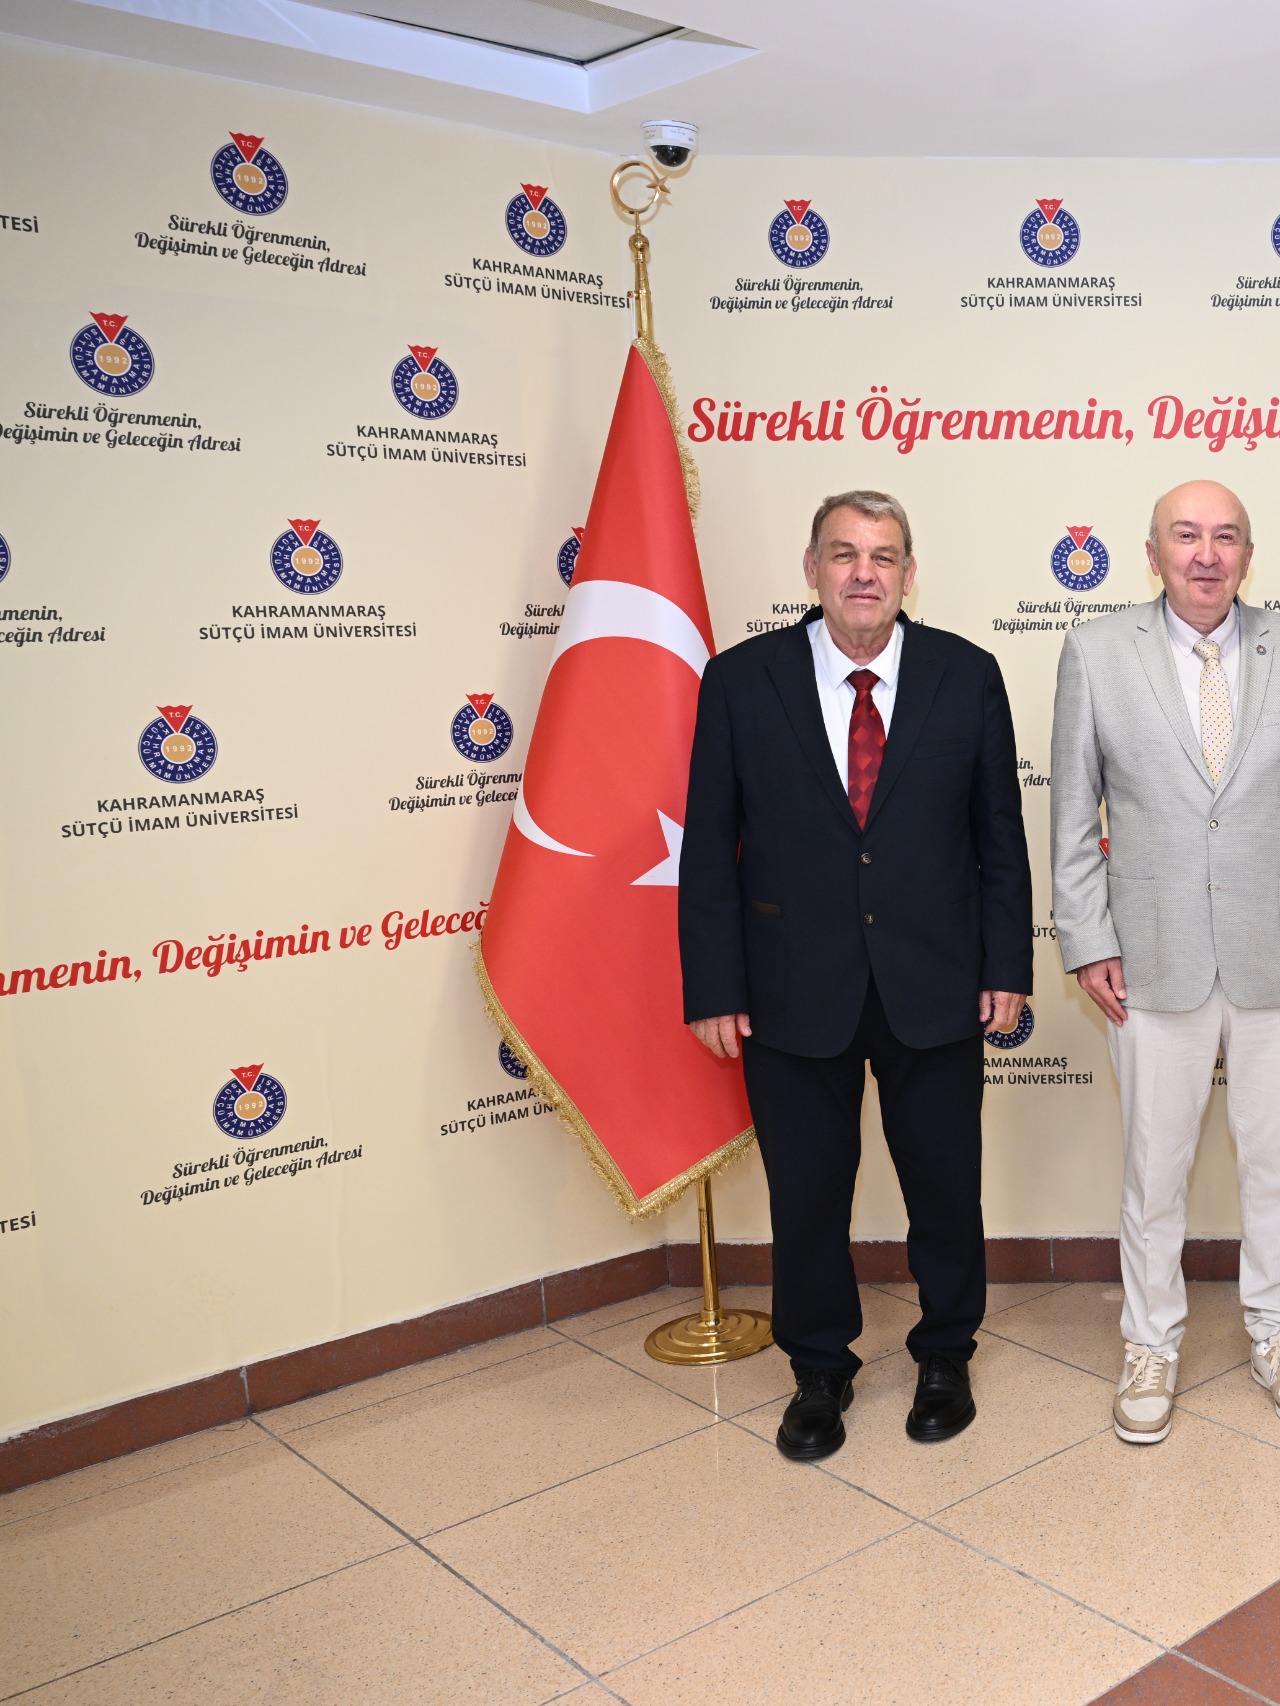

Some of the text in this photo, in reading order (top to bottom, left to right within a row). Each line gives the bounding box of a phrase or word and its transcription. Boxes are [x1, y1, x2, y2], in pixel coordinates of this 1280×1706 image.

[168, 215, 330, 253] Sürekli Öğrenmenin,
[135, 232, 366, 276] Değişimin ve Geleceğin Adresi
[473, 258, 603, 289] KAHRAMANMARAŞ
[988, 277, 1115, 291] KAHRAMANMARAŞ
[1236, 276, 1280, 289] Sürekli
[445, 273, 491, 293] SÜTÇÜ
[497, 278, 536, 297] İMAM
[735, 275, 864, 296] Sürekli Öğrenmenin,
[710, 296, 893, 313] Değişimin ve Geleceğin Adresi
[961, 293, 1141, 310] SÜTÇÜ İMAM ÜNİVERSİTESİ
[1211, 294, 1272, 311] Değişimin
[24, 402, 201, 430] Sürekli Öğrenmenin,
[688, 398, 845, 442] Sürekli
[856, 386, 1133, 454] Öğrenmenin,
[83, 433, 100, 444] ve
[105, 429, 183, 452] Geleceğin
[188, 435, 241, 452] Adresi
[357, 425, 498, 449] KAHRAMANMARAŞ
[327, 442, 526, 467] SÜTÇÜ İMAM ÜNİVERSİTESİ
[232, 605, 385, 620] KAHRAMANMARAŞ
[1017, 601, 1060, 614] Sürekli
[48, 627, 105, 644] Adresi
[199, 622, 416, 643] SÜTÇÜ İMAM ÜNİVERSİTESİ
[992, 618, 1052, 634] Değişimin
[1056, 622, 1068, 630] ve
[165, 744, 193, 753] 1992
[416, 774, 464, 790] Sürekli
[98, 788, 264, 812] KAHRAMANMARAŞ
[389, 794, 472, 813] Değişimin ve
[62, 804, 298, 838] SÜTÇÜ İMAM ÜNİVERSİTESİ
[0, 950, 142, 996] menin,
[152, 924, 331, 977] Değişimin
[340, 924, 372, 948] ve
[983, 1056, 1068, 1070] AMANMARAŞ
[1008, 1072, 1092, 1084] ÜNİVERSİTESİ
[441, 1114, 486, 1136] SÜTÇÜ
[491, 1107, 528, 1125] İMAM
[172, 1136, 328, 1179] Sürekli Öğrenmenin,
[140, 1145, 362, 1205] Değişimin ve Geleceğin Adresi
